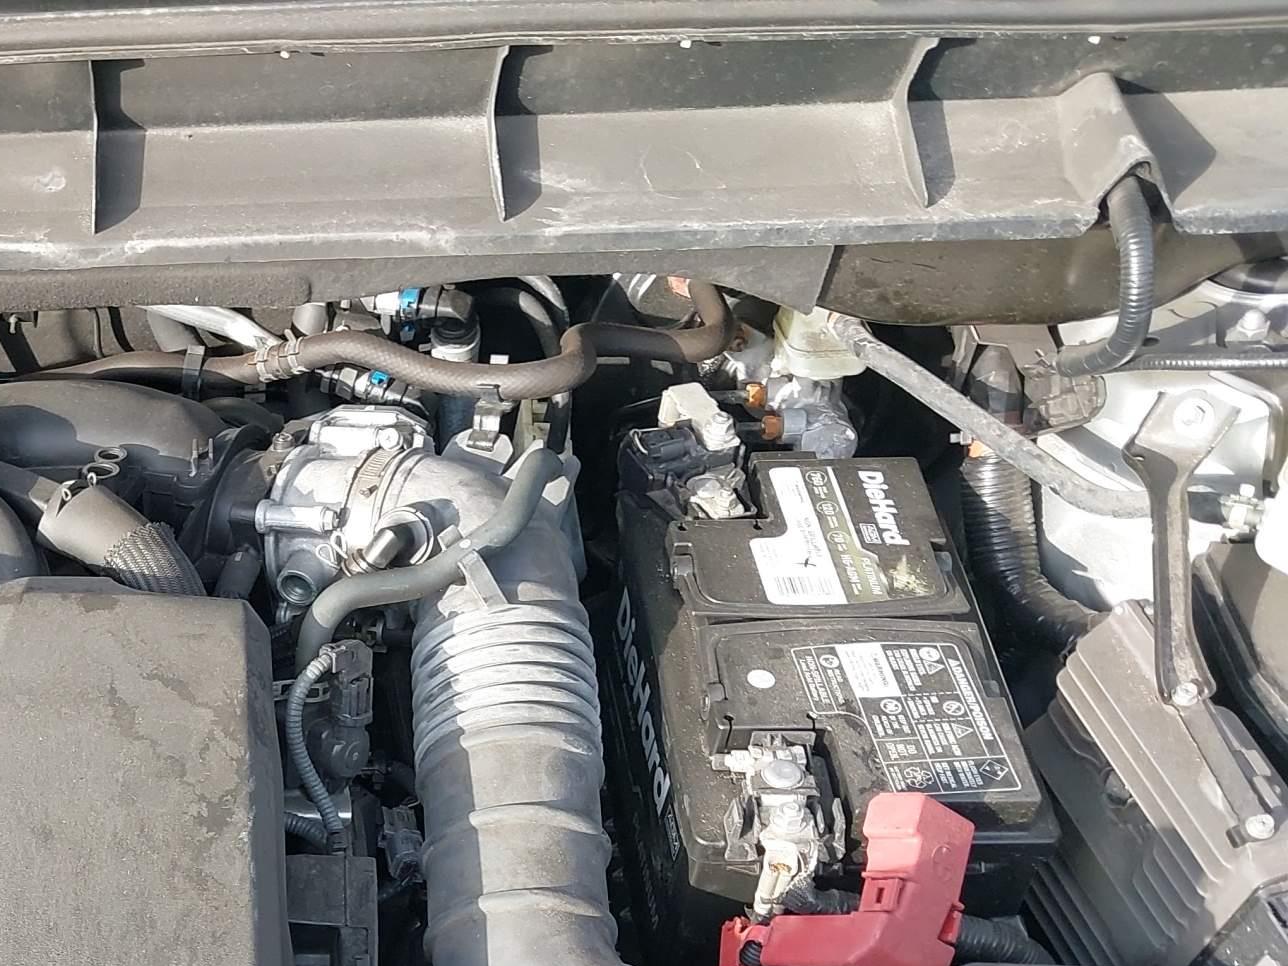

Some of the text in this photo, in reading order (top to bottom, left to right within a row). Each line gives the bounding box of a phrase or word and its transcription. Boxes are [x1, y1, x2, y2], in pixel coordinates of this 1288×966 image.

[858, 471, 911, 545] DieHard
[862, 557, 883, 595] PLATINUM
[616, 586, 670, 817] DieHard
